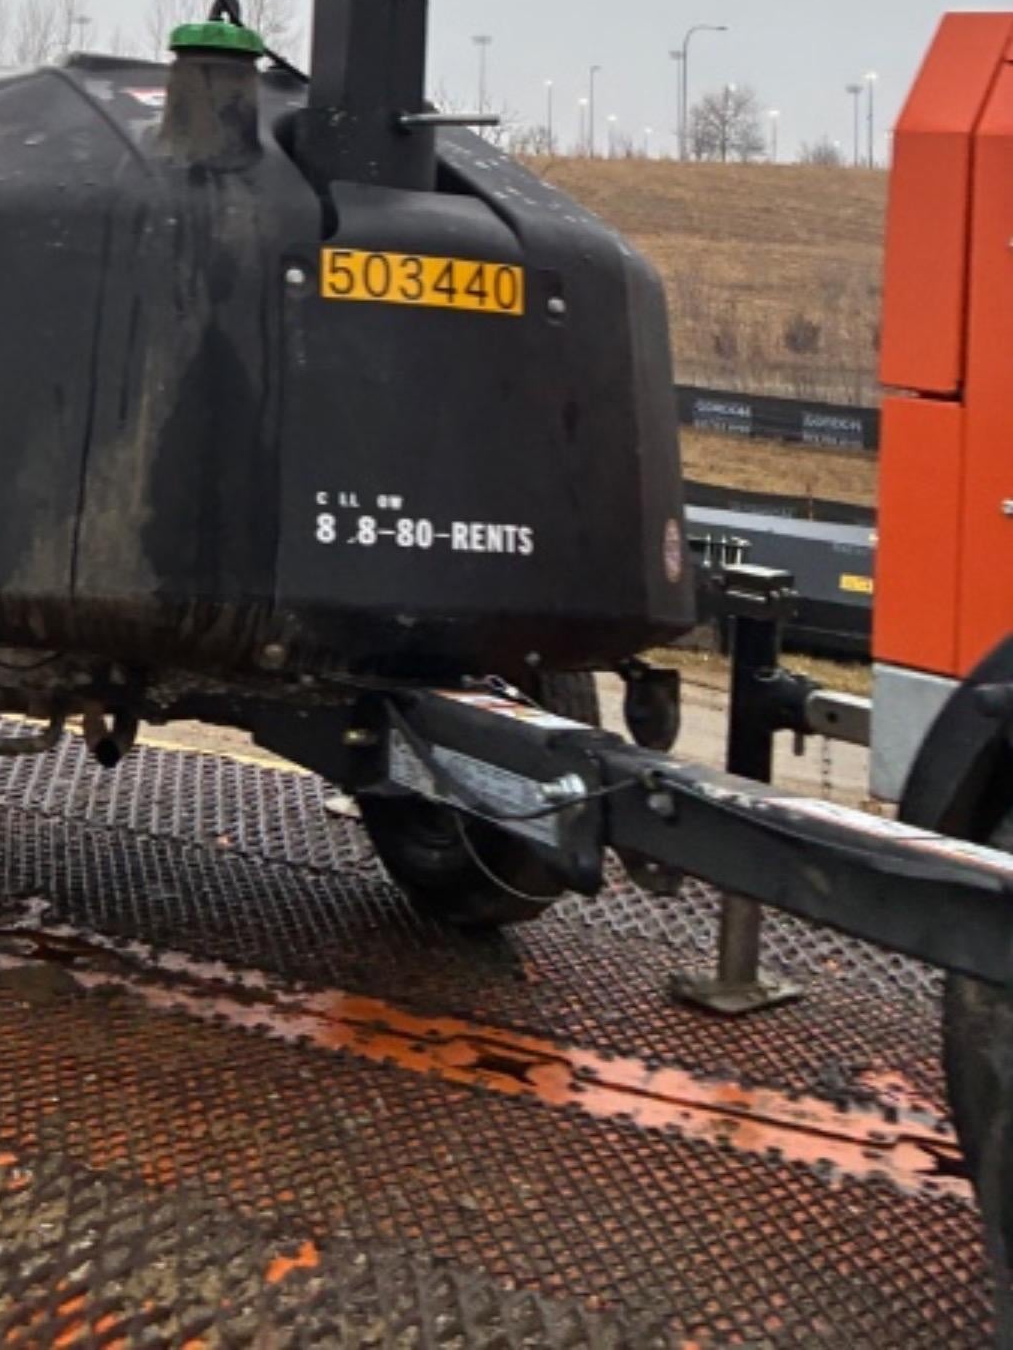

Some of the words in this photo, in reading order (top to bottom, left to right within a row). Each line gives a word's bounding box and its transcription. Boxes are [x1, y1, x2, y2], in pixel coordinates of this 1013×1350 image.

[328, 252, 518, 310] 503440
[315, 491, 360, 508] CLL
[315, 512, 534, 556] 88-80-RENTS
